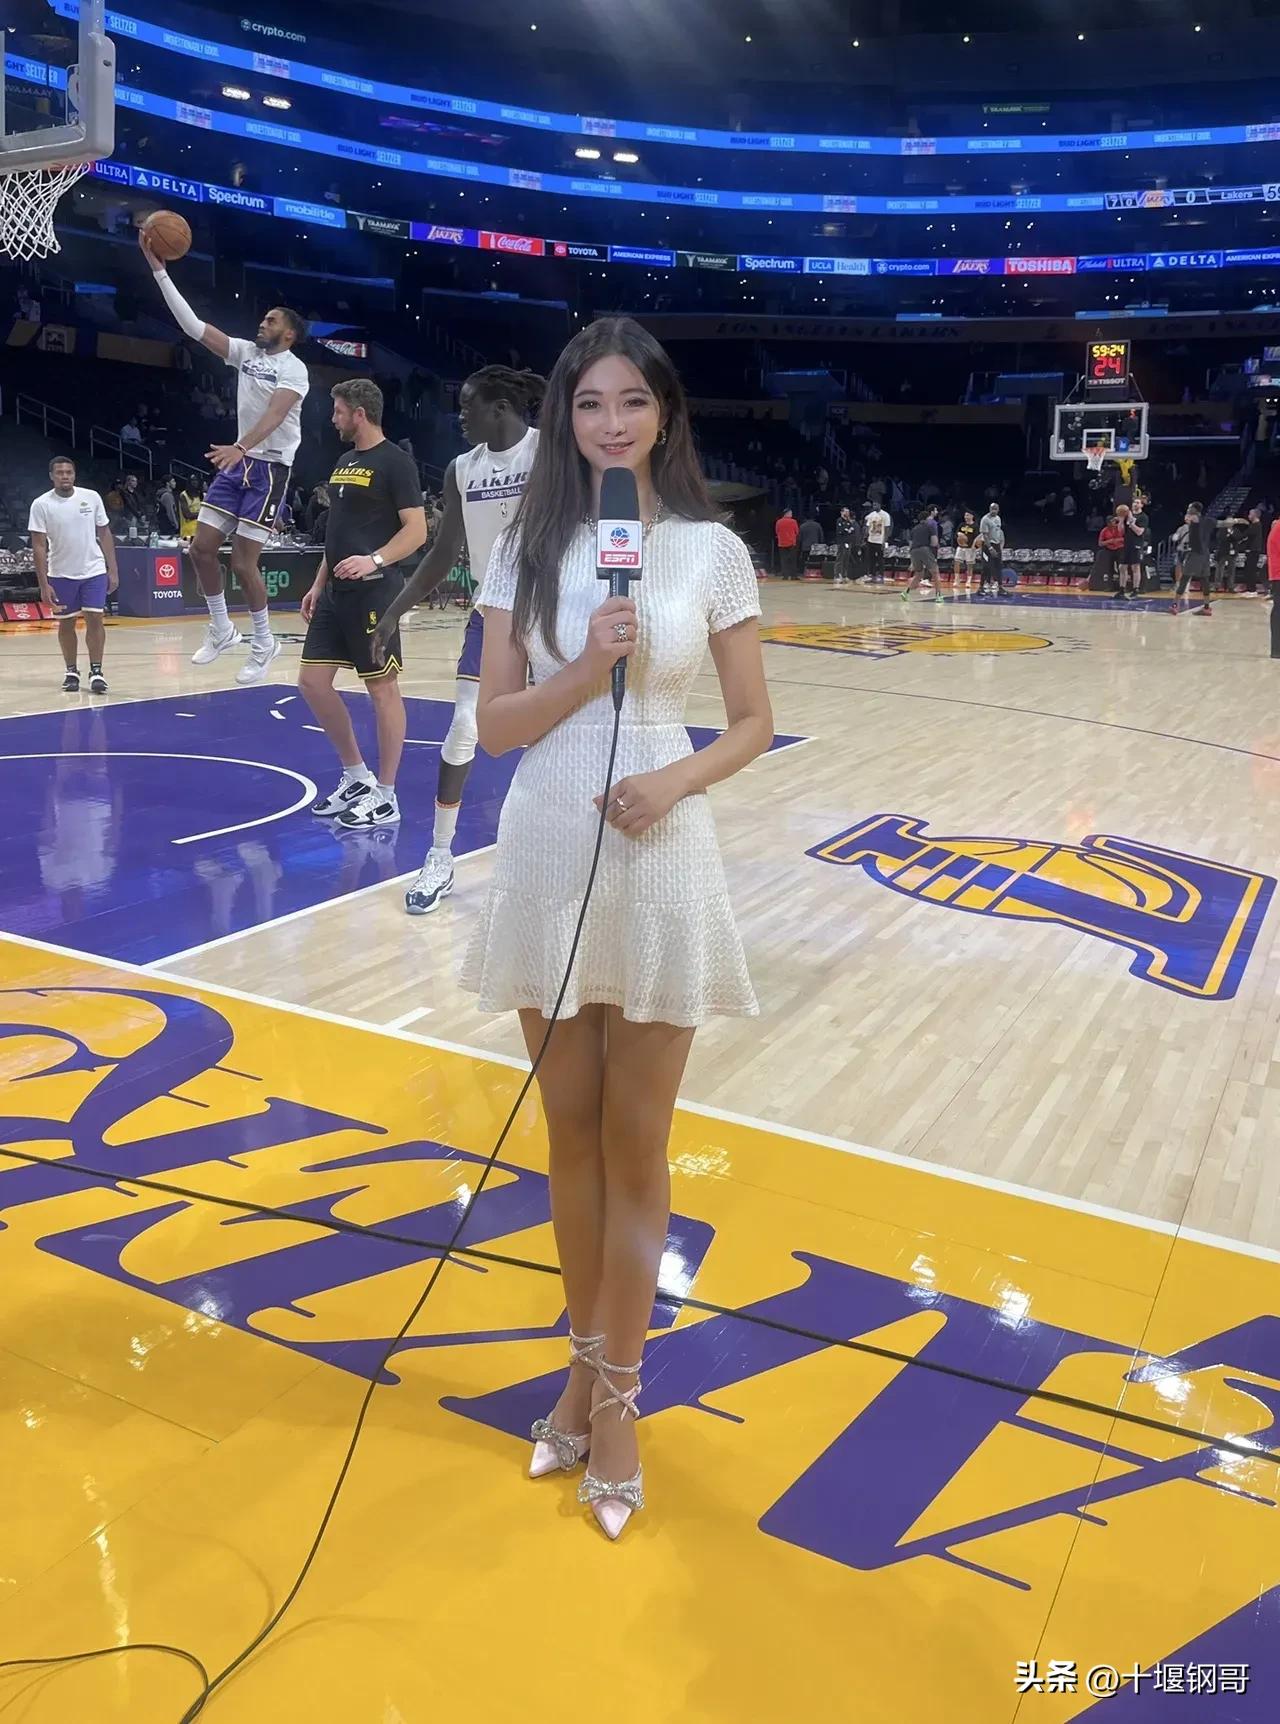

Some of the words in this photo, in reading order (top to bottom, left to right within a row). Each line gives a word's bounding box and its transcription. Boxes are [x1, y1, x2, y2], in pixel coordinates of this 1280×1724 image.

[110, 15, 138, 36] SELTZER
[252, 22, 307, 43] crypto.com
[25, 61, 59, 84] SELTZER
[95, 162, 128, 180] ULTRA
[151, 174, 197, 197] DELTA
[208, 187, 265, 209] Spectrum
[1186, 191, 1196, 204] 0
[1221, 190, 1253, 200] Lakers
[427, 225, 464, 245] LAKERS
[568, 246, 598, 257] TOYOTA
[613, 251, 644, 260] AMERICAN
[644, 253, 671, 261] EXPRESS
[1226, 253, 1261, 262] AMERICAN
[745, 257, 795, 271] Spectrum
[811, 261, 832, 270] UCLA
[837, 259, 866, 272] Health
[888, 263, 930, 271] crypto.com
[952, 259, 990, 275] LAKERS
[1008, 260, 1073, 273] TOSHIBA
[1113, 257, 1145, 268] ULTRA
[1169, 255, 1217, 266] DELTA
[1092, 344, 1125, 358] 59:24
[1094, 356, 1121, 377] 24
[1099, 377, 1126, 385] TISSOT
[332, 467, 374, 477] LAKERS
[467, 471, 529, 490] LAKER
[481, 486, 523, 499] BASKETBALL
[604, 553, 636, 563] ESPN
[153, 590, 183, 599] TOYOTA
